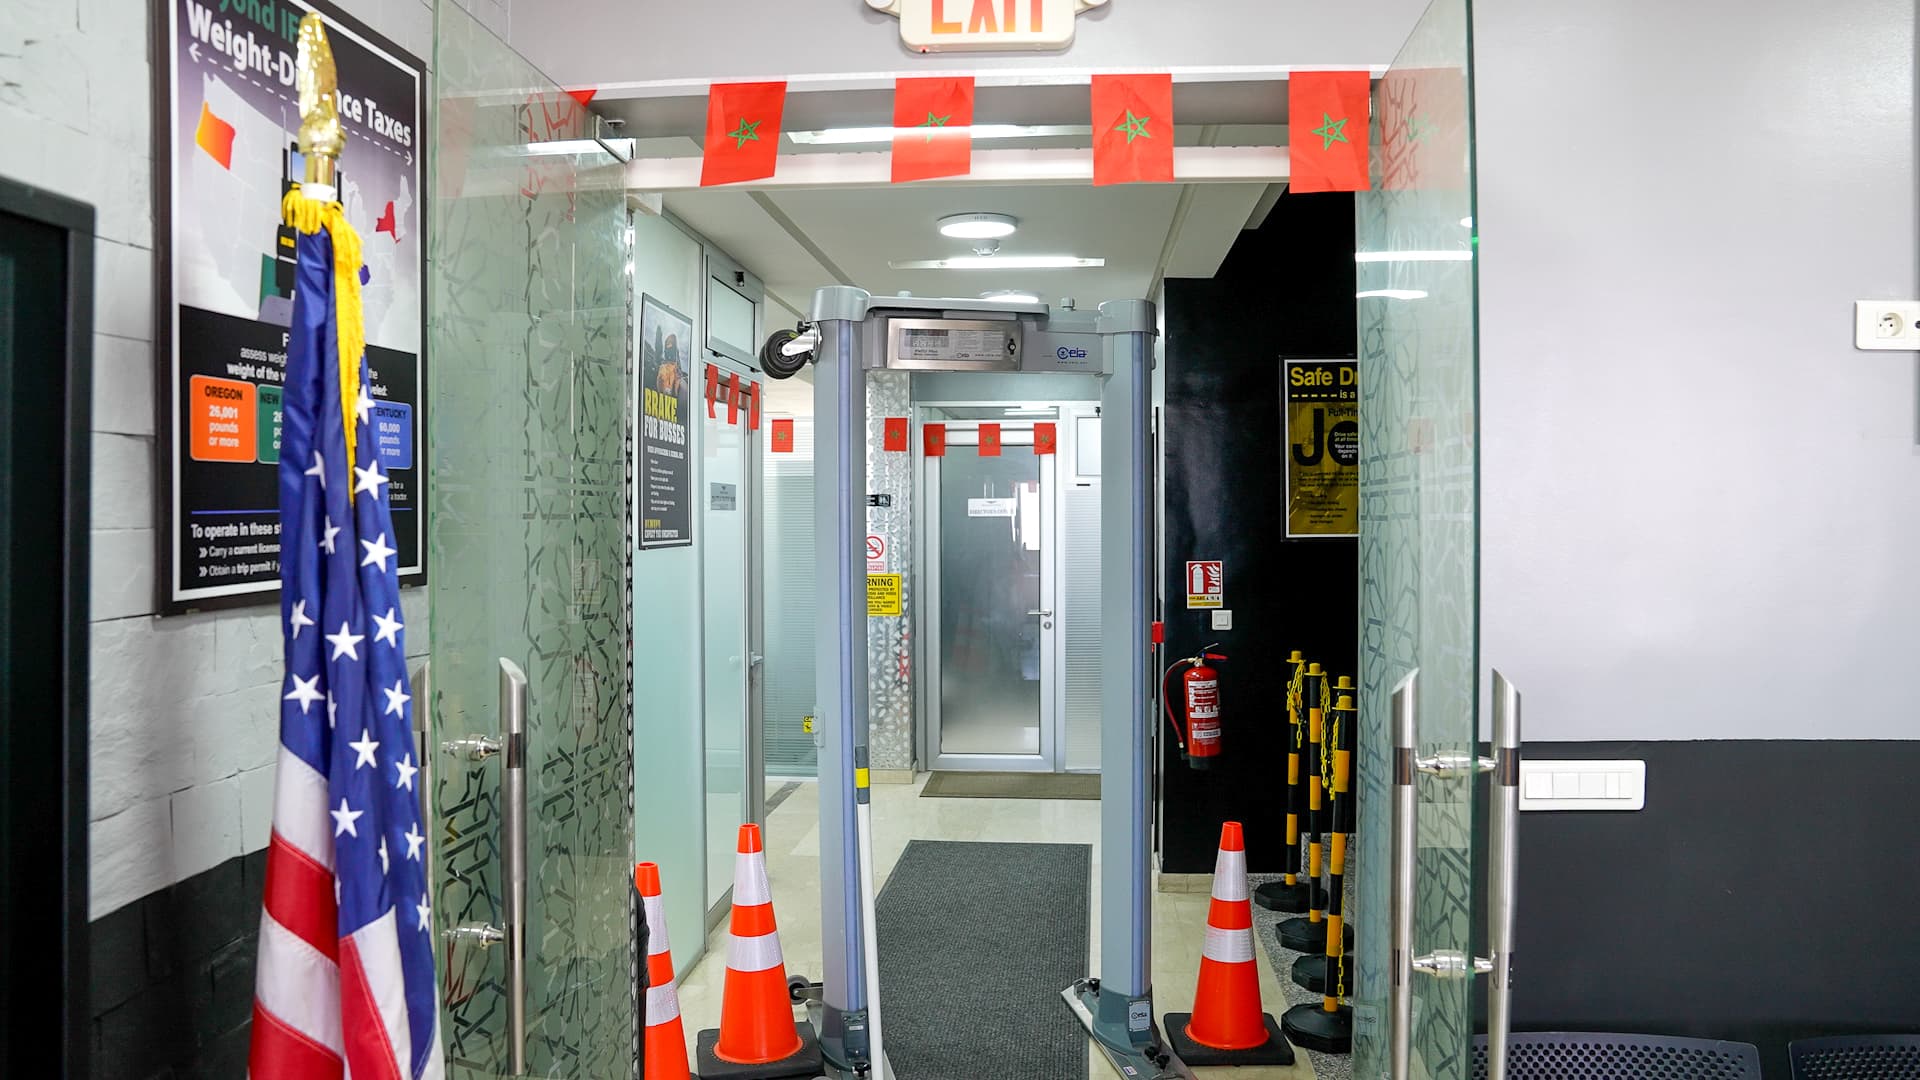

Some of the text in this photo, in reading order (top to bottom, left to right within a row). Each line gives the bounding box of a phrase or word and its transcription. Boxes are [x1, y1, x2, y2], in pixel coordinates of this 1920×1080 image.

[364, 98, 411, 147] Taxes
[240, 347, 288, 368] assess weigh
[226, 362, 255, 380] weight
[256, 366, 266, 379] of
[266, 367, 280, 381] the
[1290, 367, 1333, 386] Safe
[204, 385, 243, 400] OREGON
[260, 392, 280, 405] NEW
[1340, 390, 1347, 398] is
[208, 404, 238, 420] 26,001
[375, 407, 407, 419] ENTUCKY
[645, 387, 677, 424] BRAKE
[208, 421, 239, 434] pounds
[644, 415, 685, 446] FOR BUSSES
[208, 436, 240, 447] or more
[379, 435, 400, 446] pounds
[1292, 408, 1358, 466] JO
[190, 523, 203, 538] To
[204, 523, 239, 541] operate
[239, 522, 249, 536] in
[249, 522, 273, 536] these
[208, 545, 227, 559] Carry
[228, 547, 233, 556] a
[233, 543, 258, 555] current
[208, 564, 230, 576] Obtain
[231, 565, 237, 575] a
[236, 562, 249, 576] trip
[249, 560, 271, 575] permit
[866, 578, 893, 587] RNING
